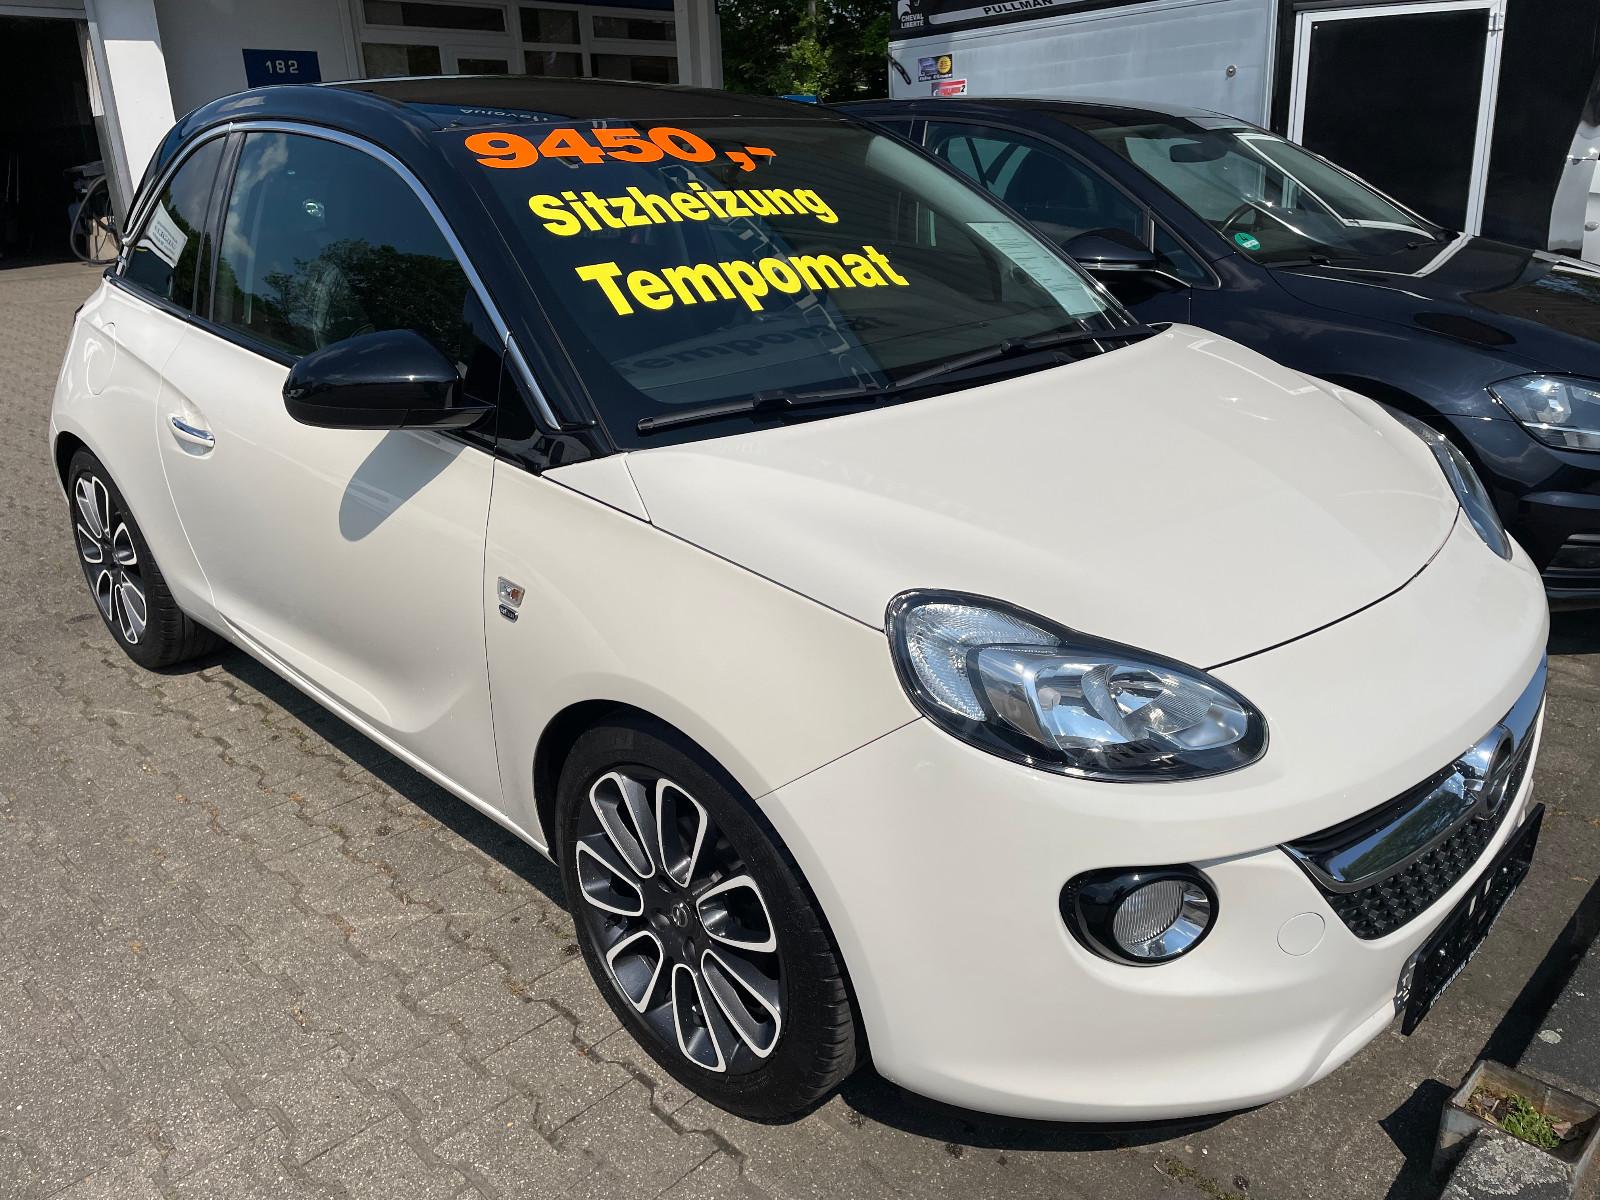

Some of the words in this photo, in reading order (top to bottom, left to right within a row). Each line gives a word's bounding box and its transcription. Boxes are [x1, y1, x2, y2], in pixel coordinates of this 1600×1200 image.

[983, 0, 1054, 15] PULLMAN
[901, 13, 925, 23] CHEVAL
[265, 60, 299, 74] 182
[528, 184, 838, 236] Sitzheizung
[575, 245, 909, 316] Tempomat
